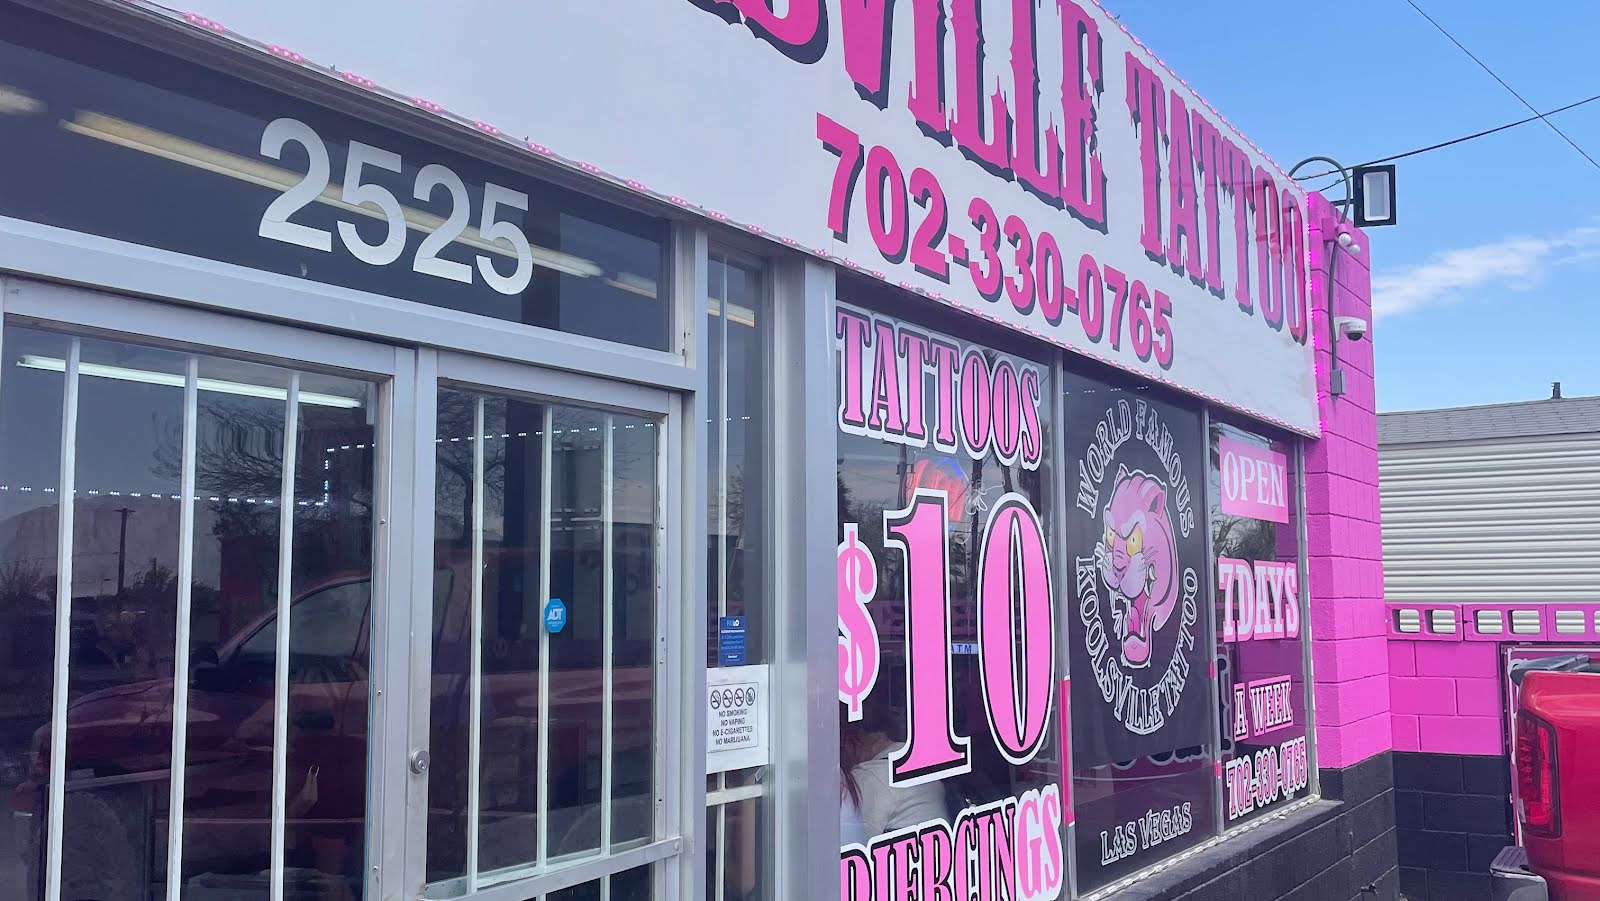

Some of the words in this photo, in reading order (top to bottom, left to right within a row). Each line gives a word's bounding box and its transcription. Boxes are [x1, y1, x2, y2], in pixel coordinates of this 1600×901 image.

[258, 117, 533, 295] 2525
[1125, 51, 1308, 346] TATTOO
[816, 112, 1174, 371] 702-330-0765
[837, 306, 1041, 465] TATTOOS
[1076, 398, 1131, 519] WORLD
[1135, 398, 1195, 539] FAMOUS
[1223, 450, 1286, 508] OPEN
[547, 608, 563, 621] ADT
[838, 489, 1054, 783] $10
[1075, 555, 1165, 735] KOOLSVILLE
[720, 725, 753, 736] E-CIGARETTES
[724, 735, 751, 744] MARIJUANA
[727, 708, 748, 717] SMOKING
[729, 717, 746, 726] VAPING
[1235, 686, 1248, 739] A
[1250, 678, 1292, 734] WEEK
[1227, 738, 1306, 818] 702-330-0765
[1101, 820, 1137, 866] LAS
[1138, 801, 1193, 850] VEGAS
